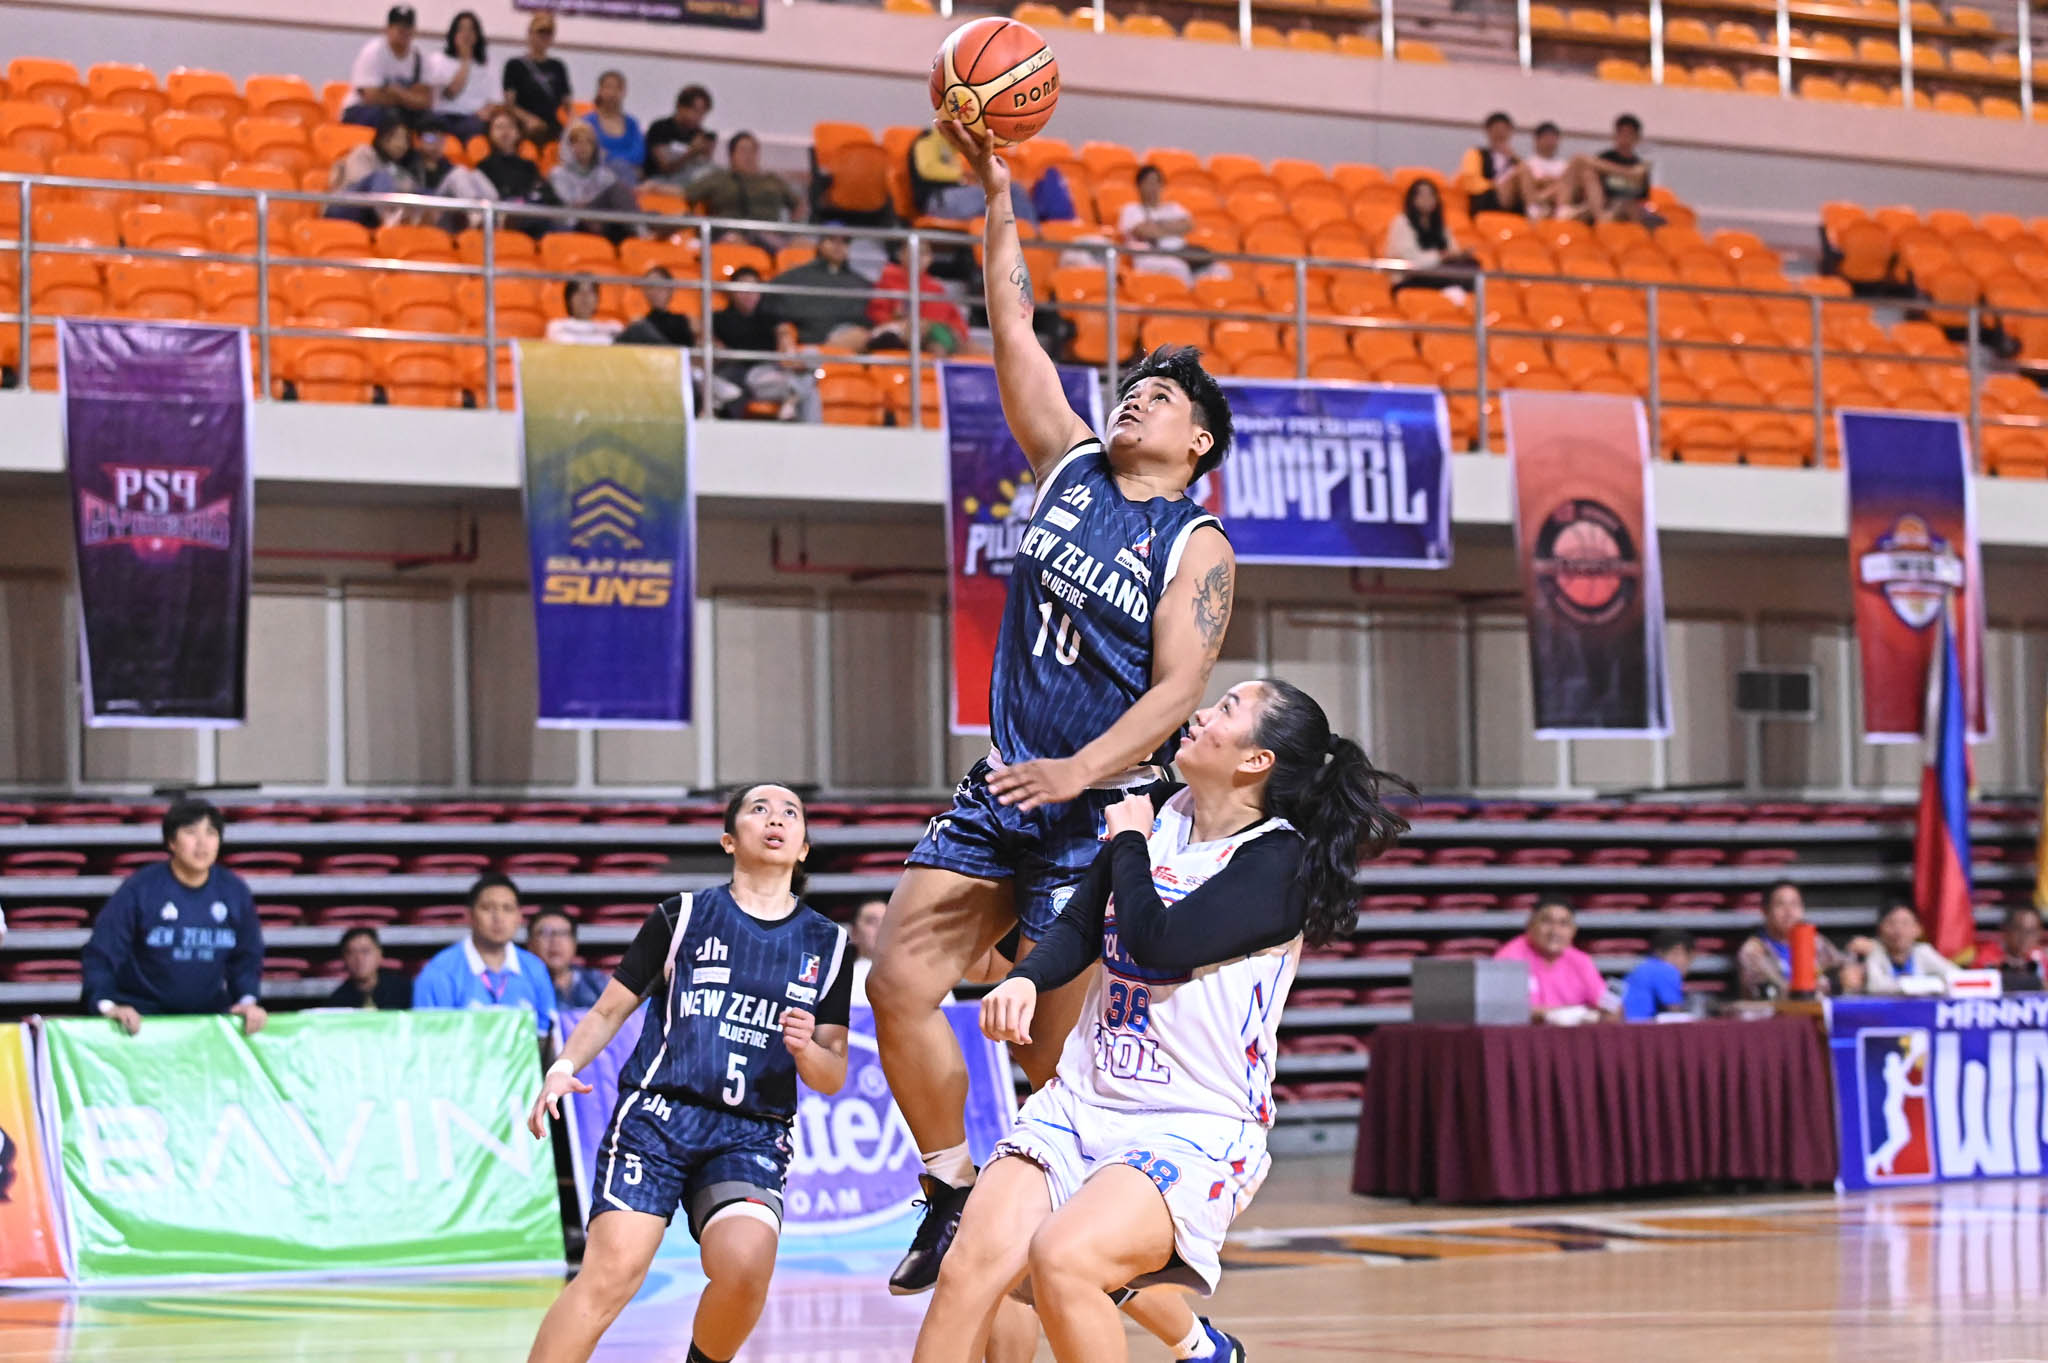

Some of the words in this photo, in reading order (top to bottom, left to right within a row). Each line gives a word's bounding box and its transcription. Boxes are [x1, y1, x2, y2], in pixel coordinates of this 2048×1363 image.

[1226, 435, 1428, 524] WMPBL
[542, 575, 673, 607] SUNS
[1018, 525, 1062, 562] NEW
[1051, 541, 1149, 624] ZEALAND
[1041, 569, 1088, 610] BLUEFIRE
[1032, 601, 1081, 666] 10
[680, 988, 726, 1018] NEW
[1104, 979, 1152, 1036] 38
[718, 1020, 770, 1049] BLUEFIRE
[722, 1052, 748, 1106] 5
[623, 1153, 643, 1185] 5
[788, 1188, 863, 1215] OAM
